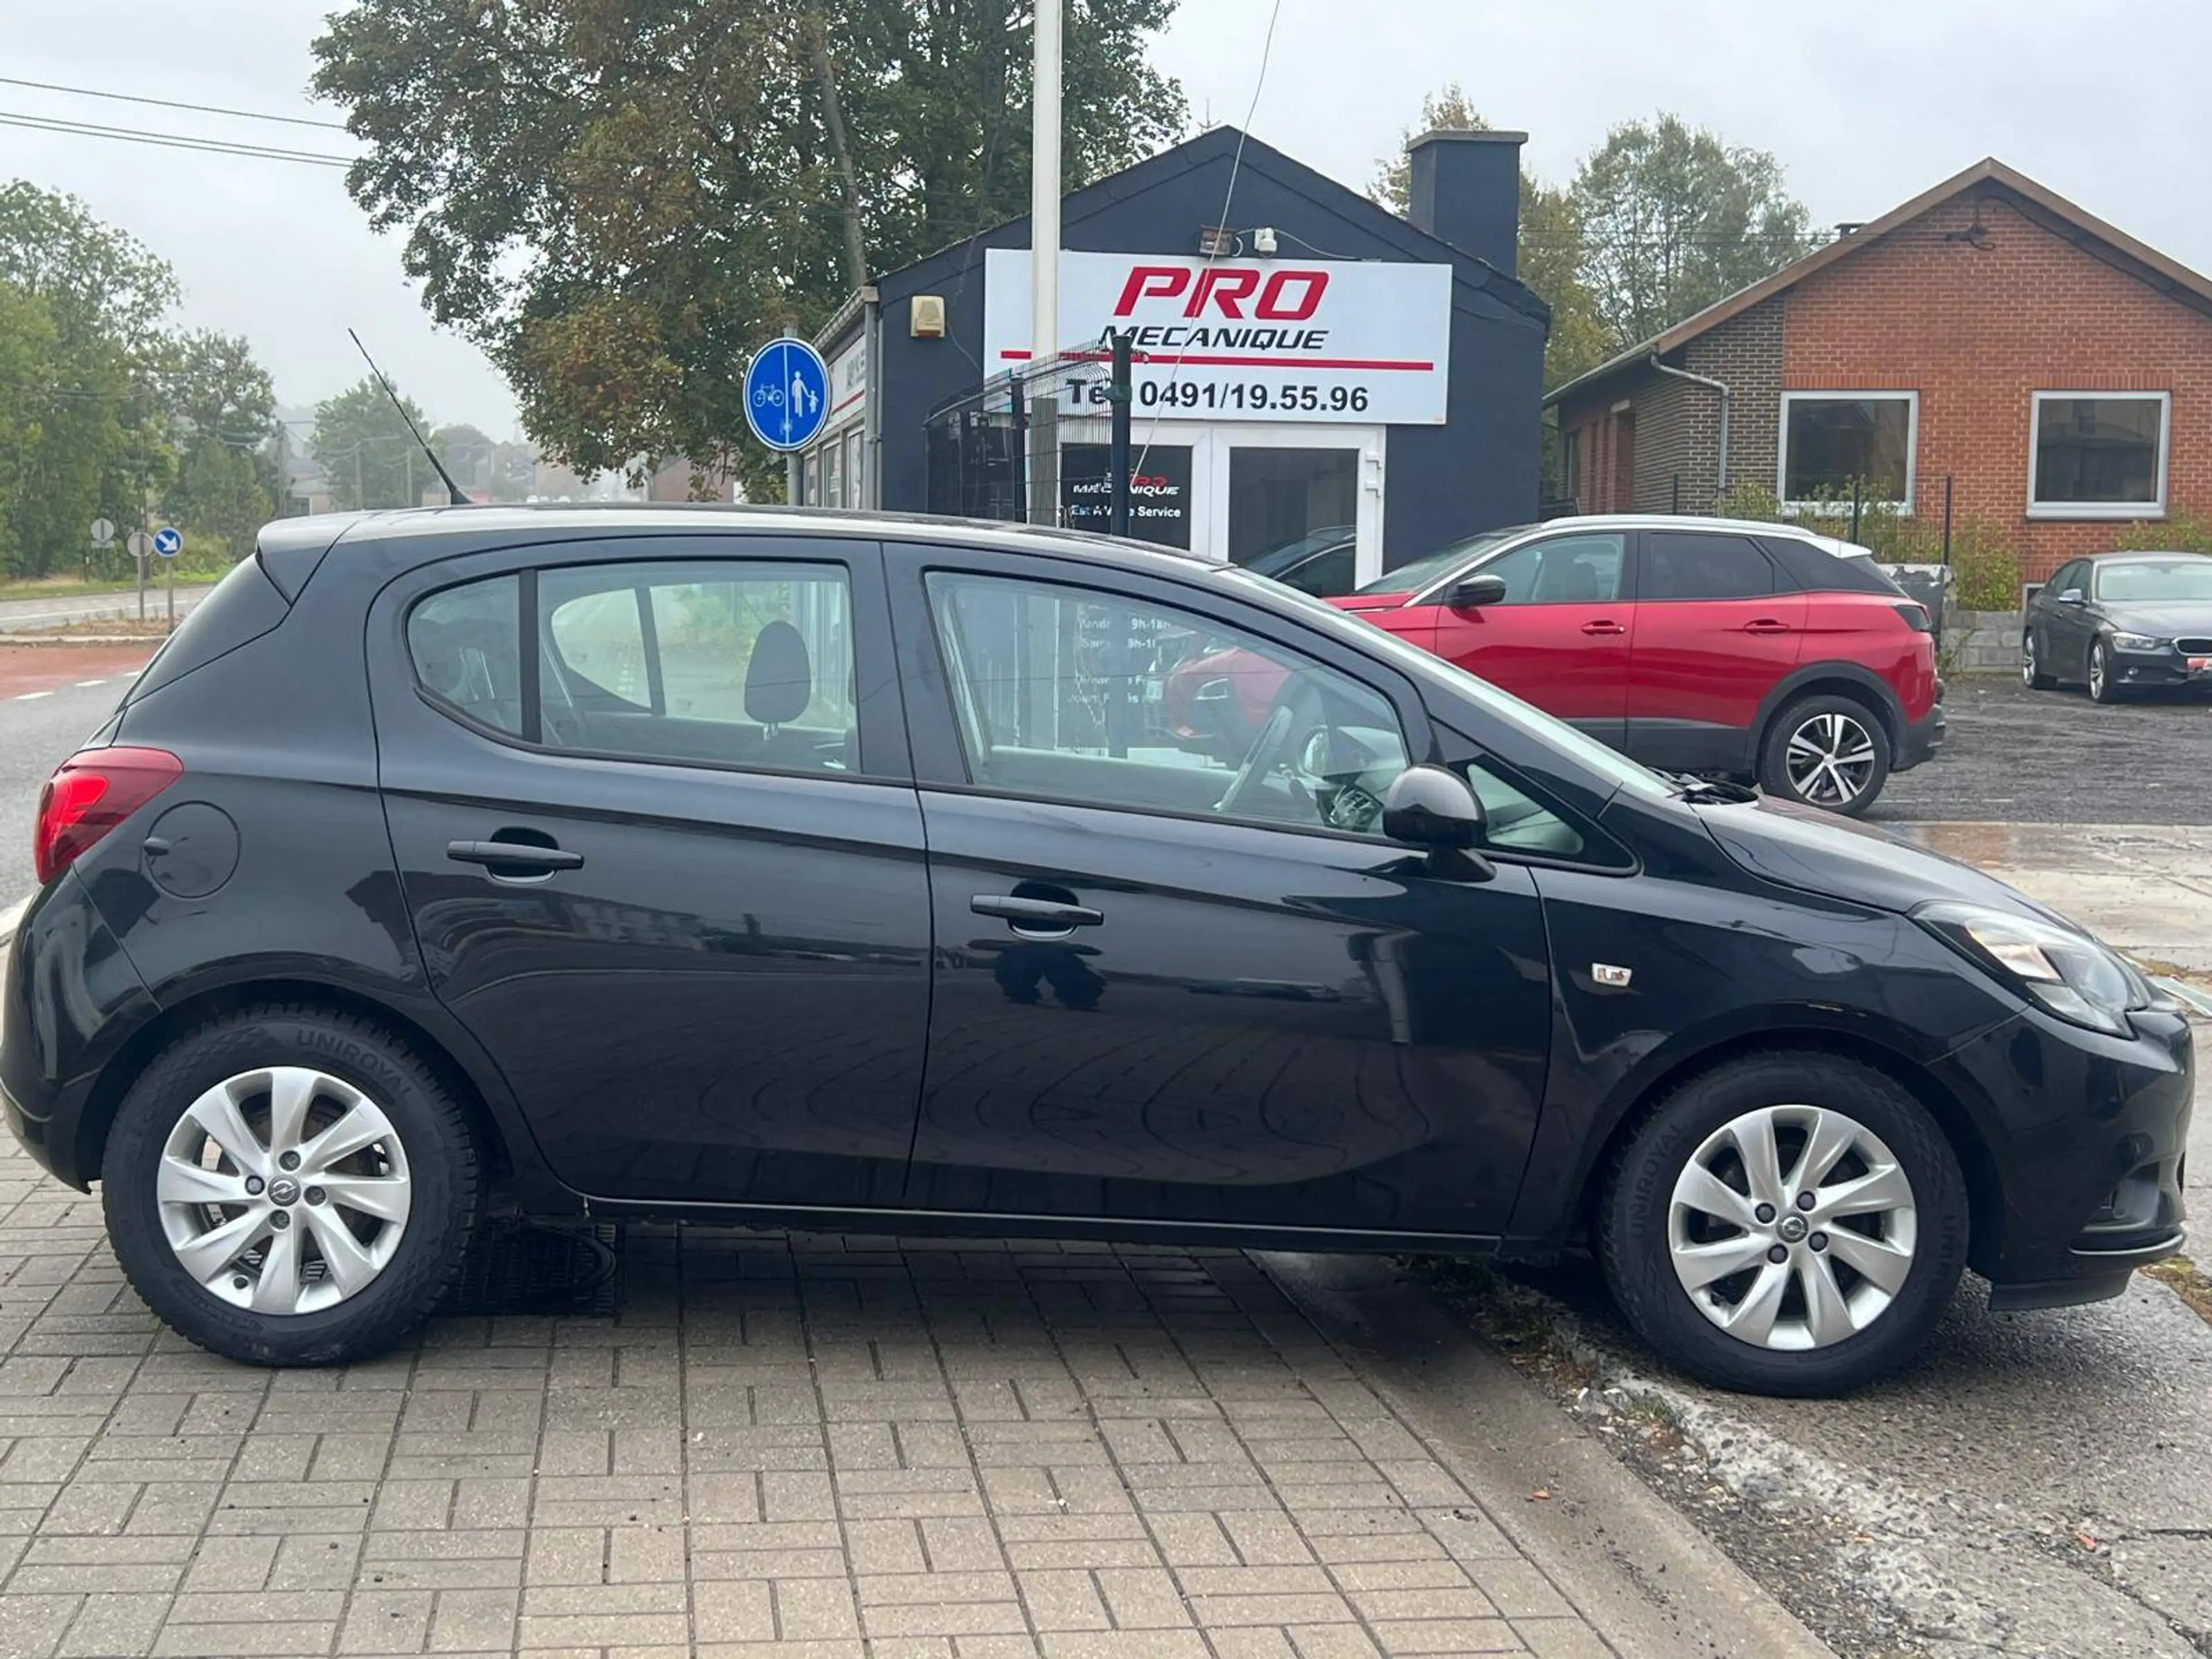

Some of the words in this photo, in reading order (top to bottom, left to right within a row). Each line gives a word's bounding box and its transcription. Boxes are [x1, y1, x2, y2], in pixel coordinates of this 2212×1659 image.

[1113, 266, 1330, 321] PRO
[1098, 325, 1329, 350] MECANIQUE
[1139, 380, 1369, 412] 0491/19.55.96
[1073, 482, 1180, 497] MECNIQUE
[1137, 505, 1181, 518] Service
[296, 1028, 412, 1095] UNIROYAL
